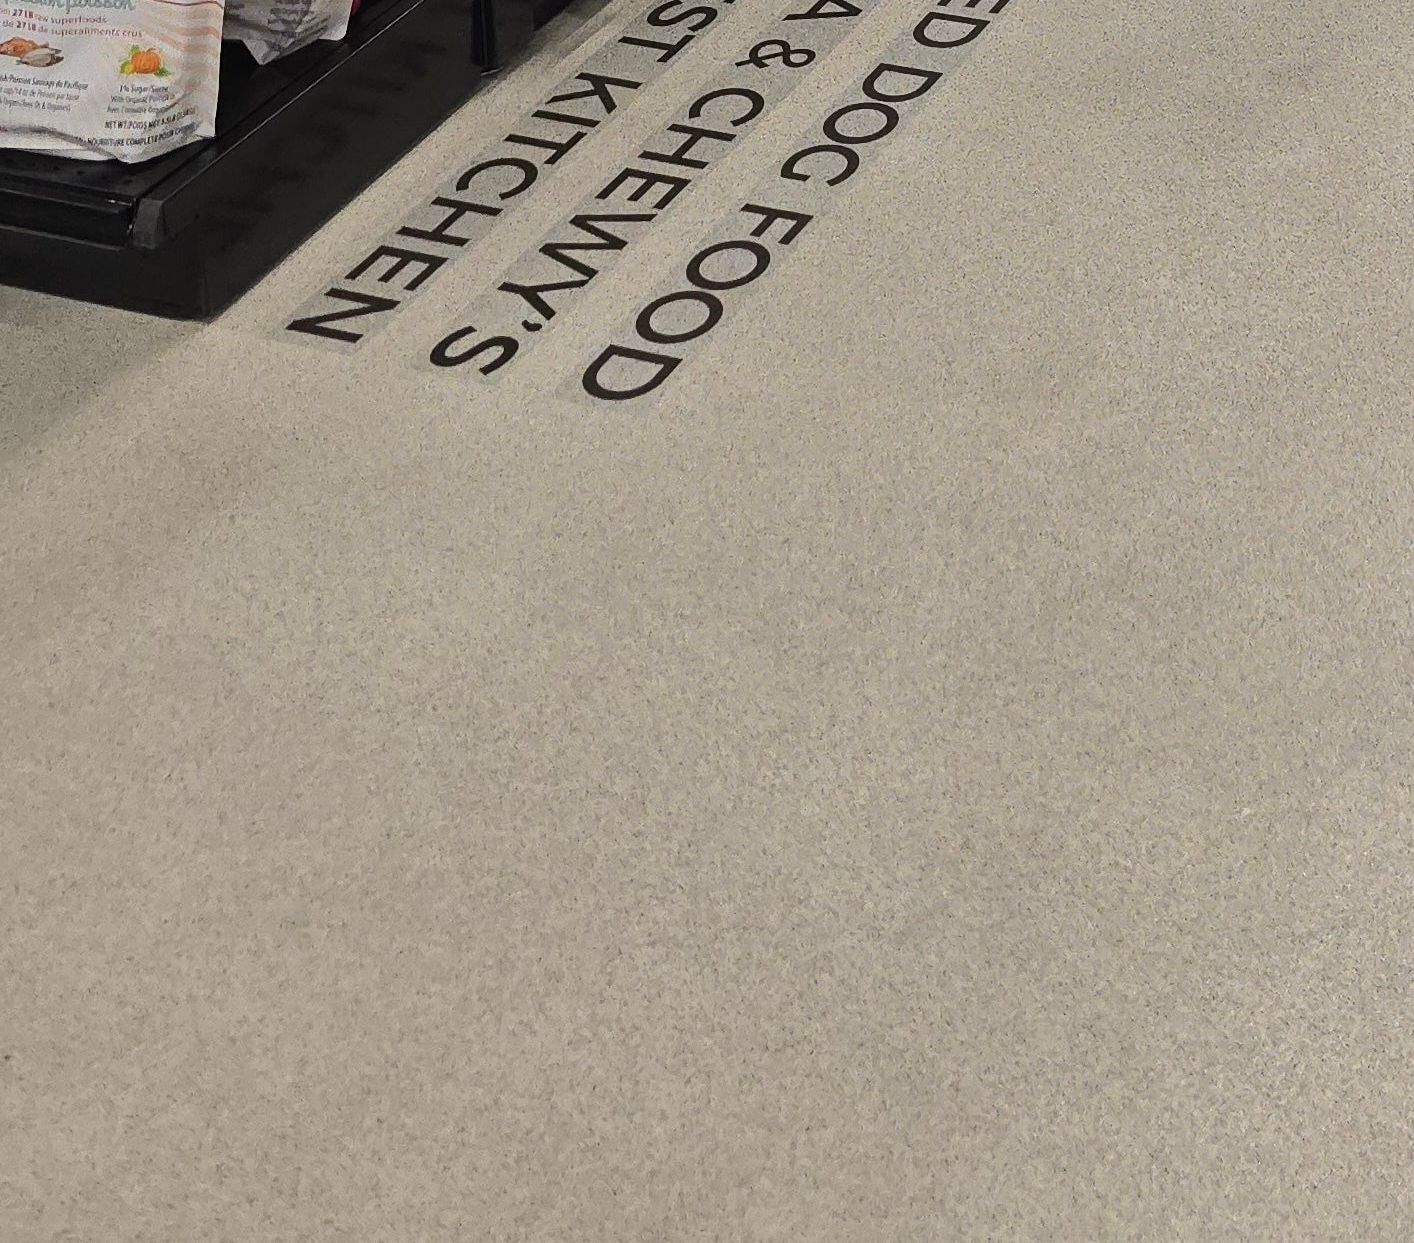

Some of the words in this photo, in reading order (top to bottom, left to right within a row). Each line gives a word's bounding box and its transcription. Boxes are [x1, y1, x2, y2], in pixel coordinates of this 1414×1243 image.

[734, 36, 816, 72] &
[781, 63, 943, 188] DOG
[285, 70, 641, 344] KITCHEN
[430, 87, 766, 378] CHEWY'S
[581, 203, 814, 402] FOOD
